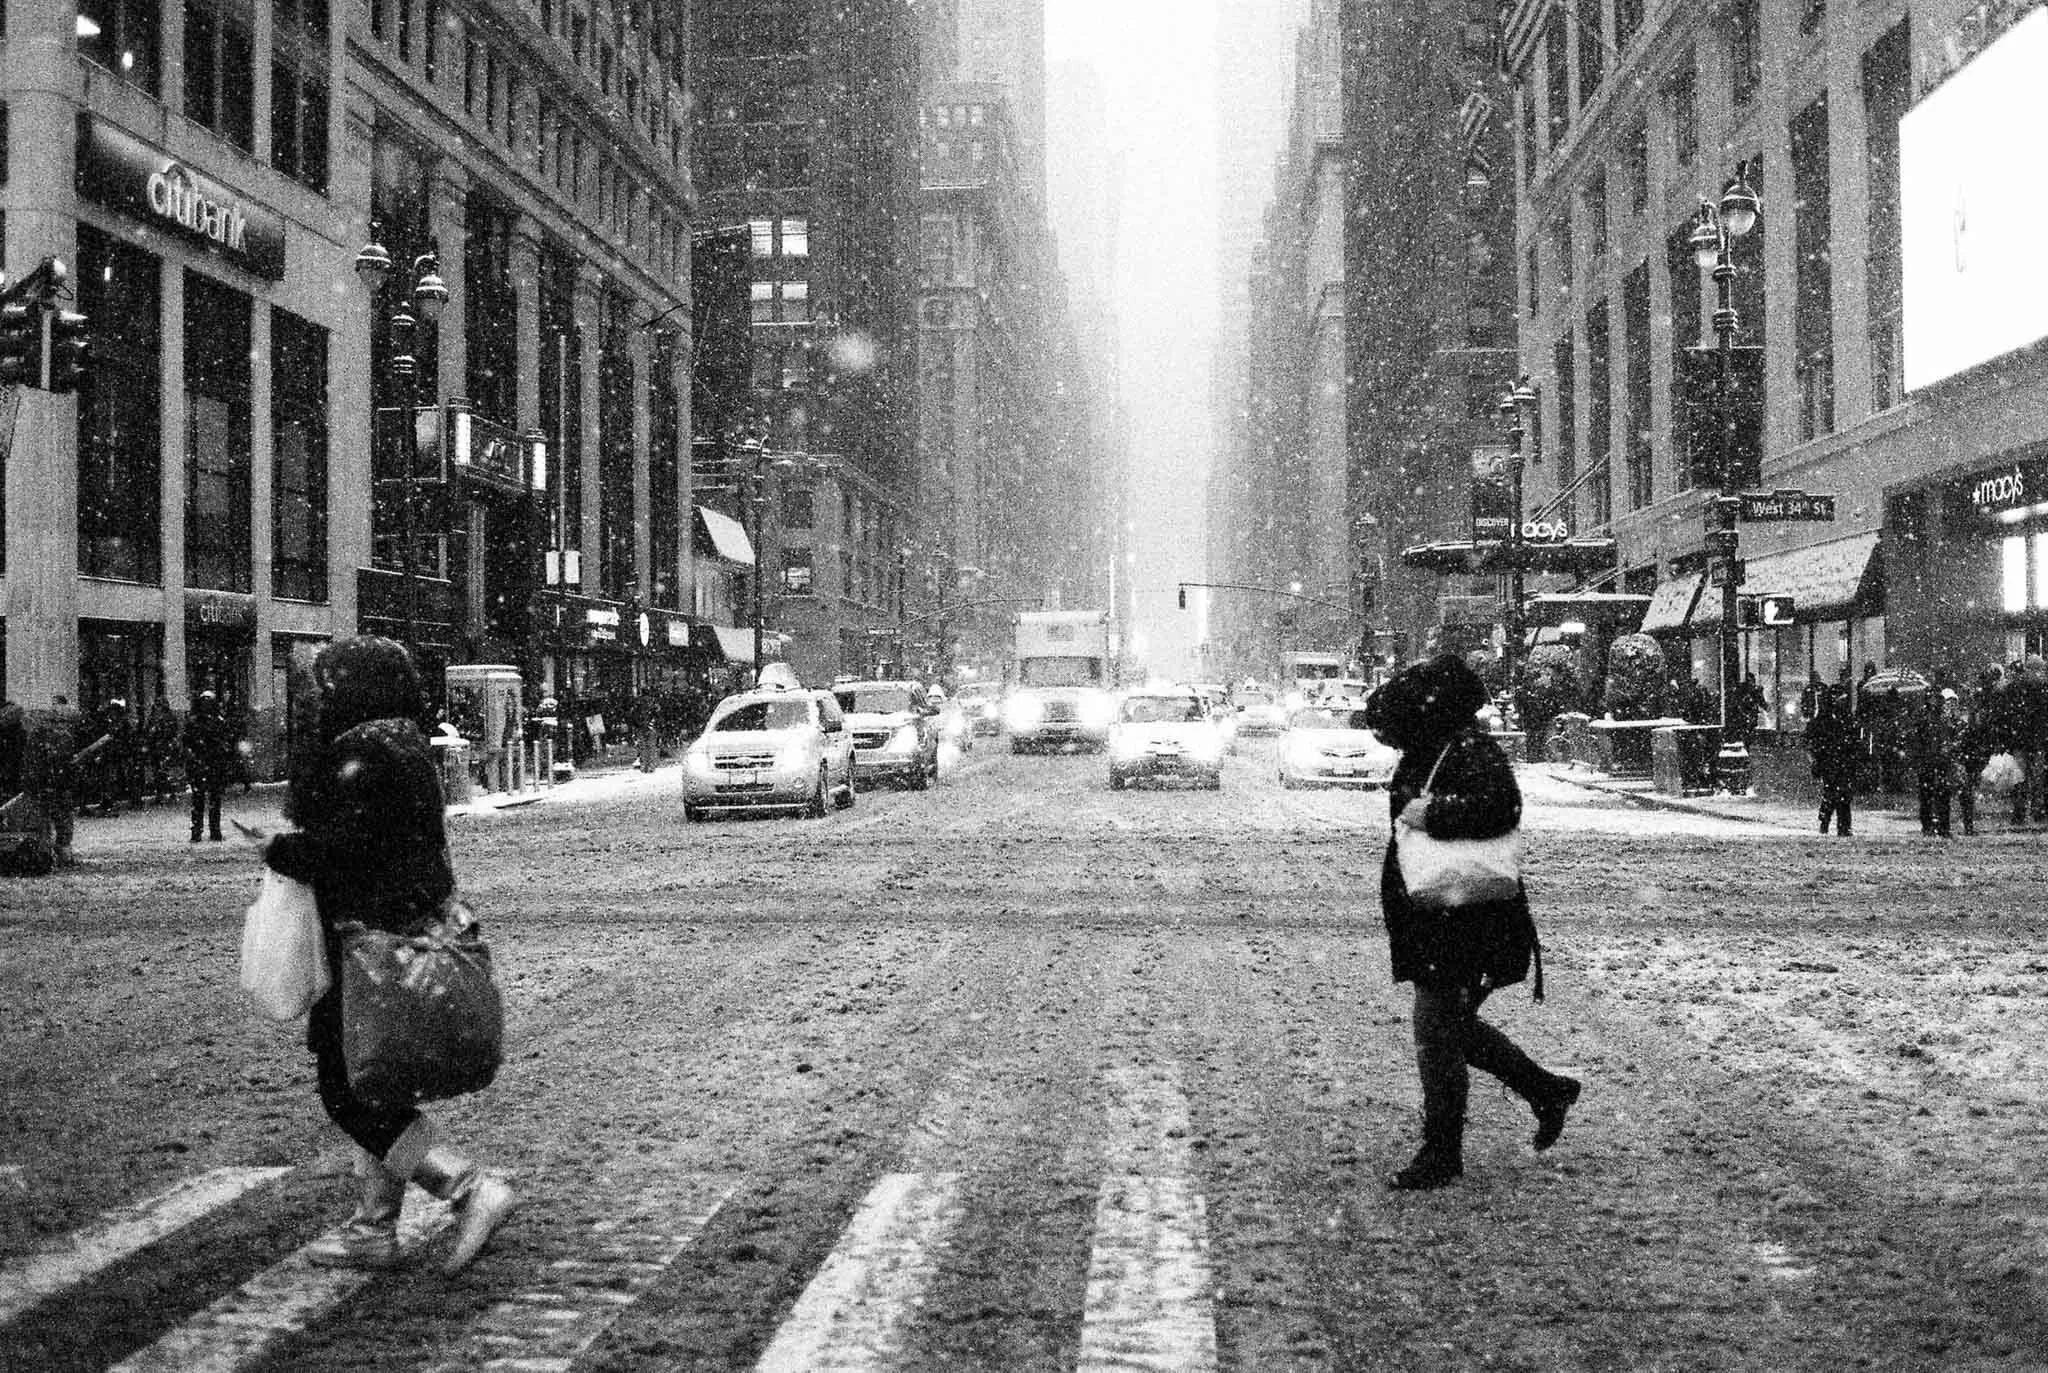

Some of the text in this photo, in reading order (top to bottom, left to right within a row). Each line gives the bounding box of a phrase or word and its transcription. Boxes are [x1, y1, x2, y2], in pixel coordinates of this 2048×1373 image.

[146, 164, 247, 253] citibank
[1981, 463, 2024, 505] macy's
[1752, 501, 1784, 516] West
